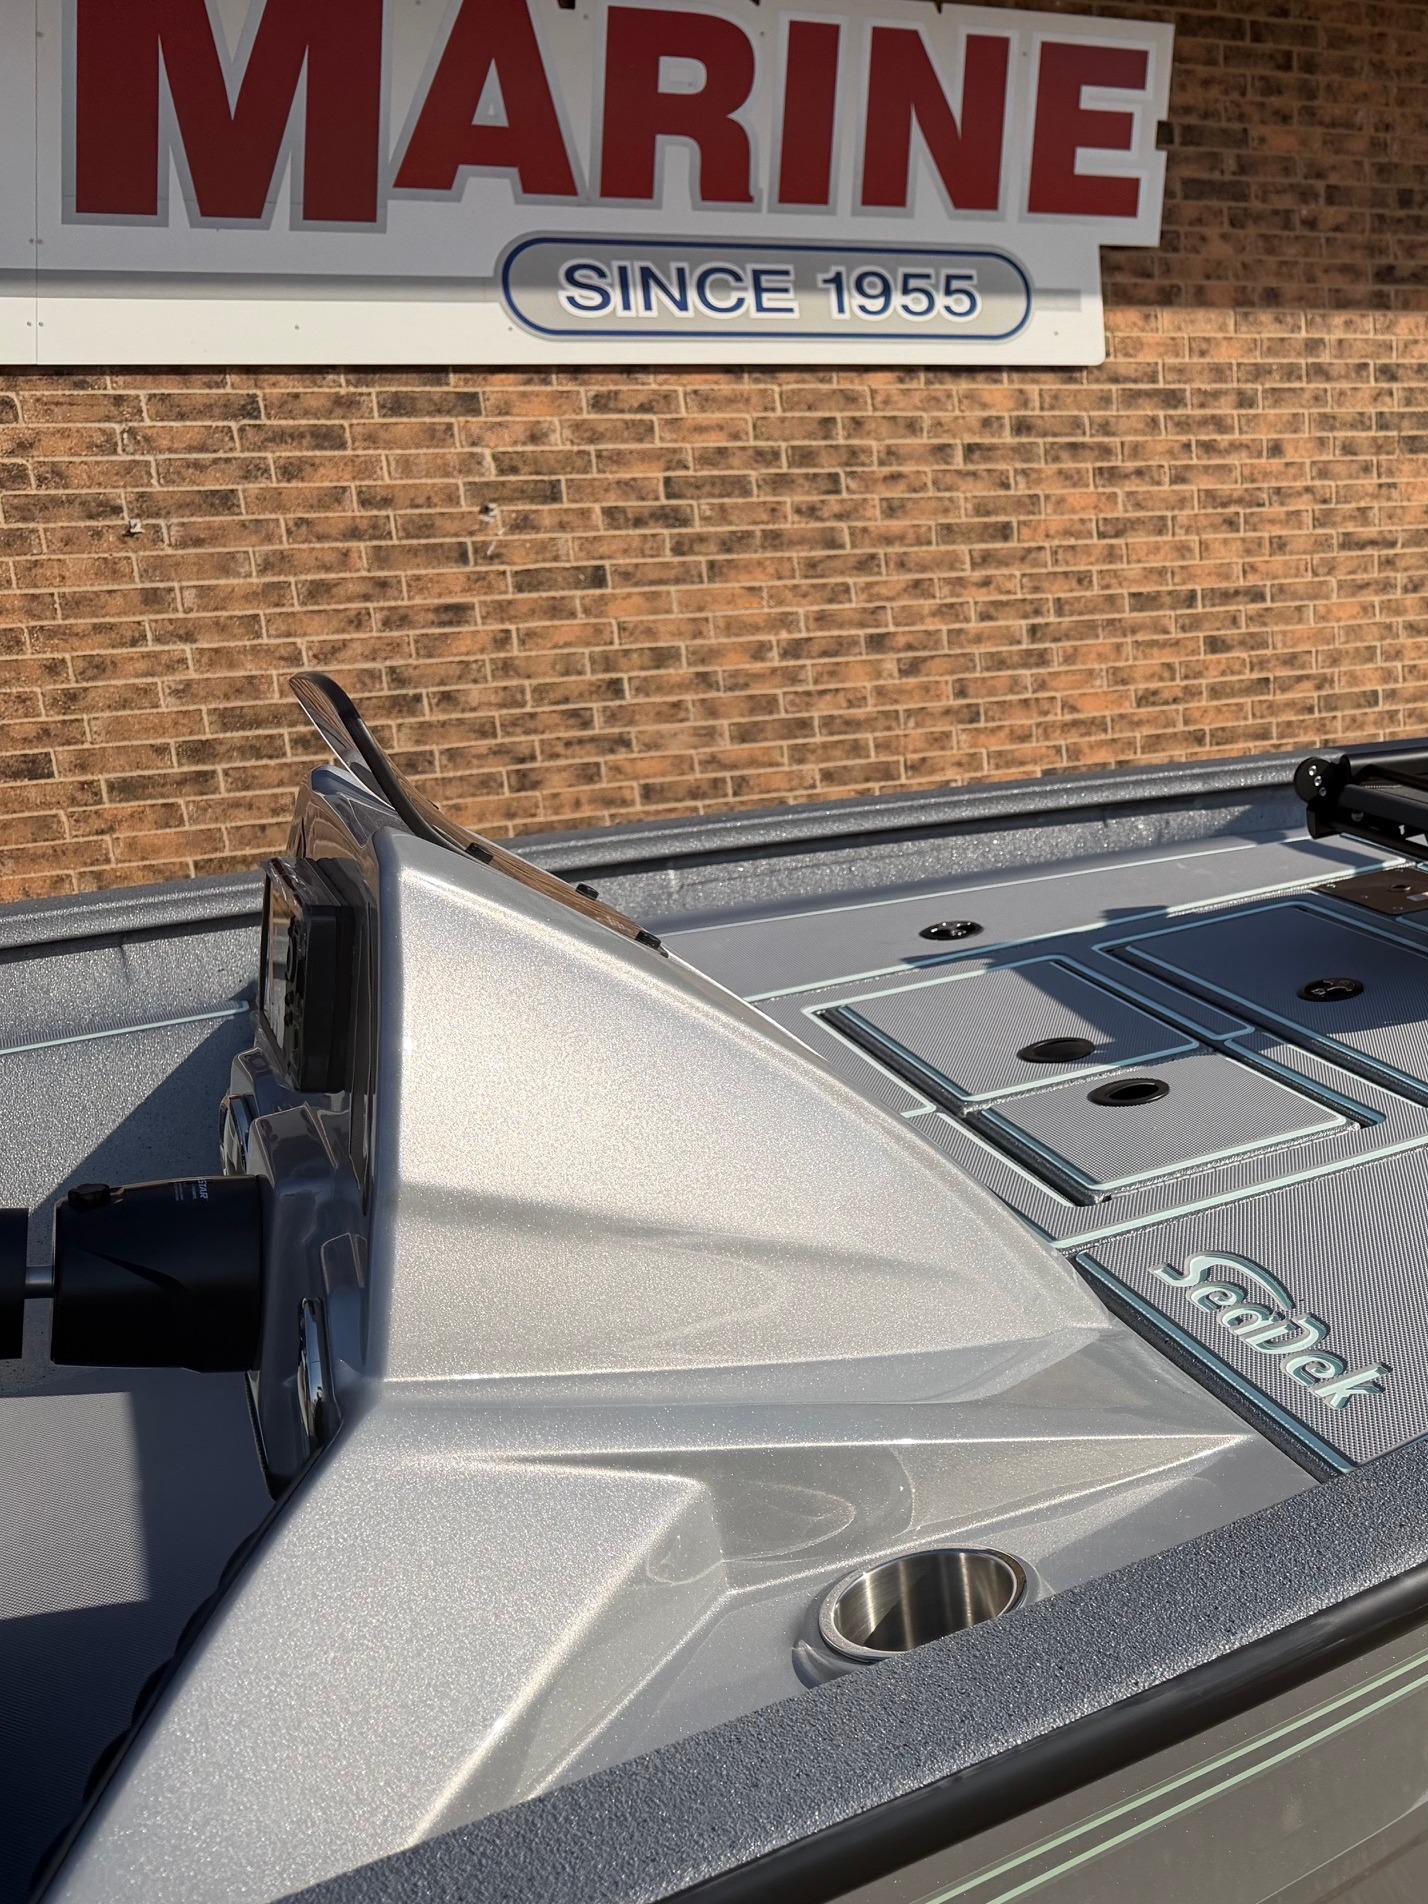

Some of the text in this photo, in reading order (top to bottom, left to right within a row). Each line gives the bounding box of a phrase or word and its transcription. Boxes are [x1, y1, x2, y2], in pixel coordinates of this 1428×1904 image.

[70, 0, 1154, 222] MARINE
[560, 260, 981, 319] SINCE 1955
[1151, 1250, 1393, 1410] SeaDek
